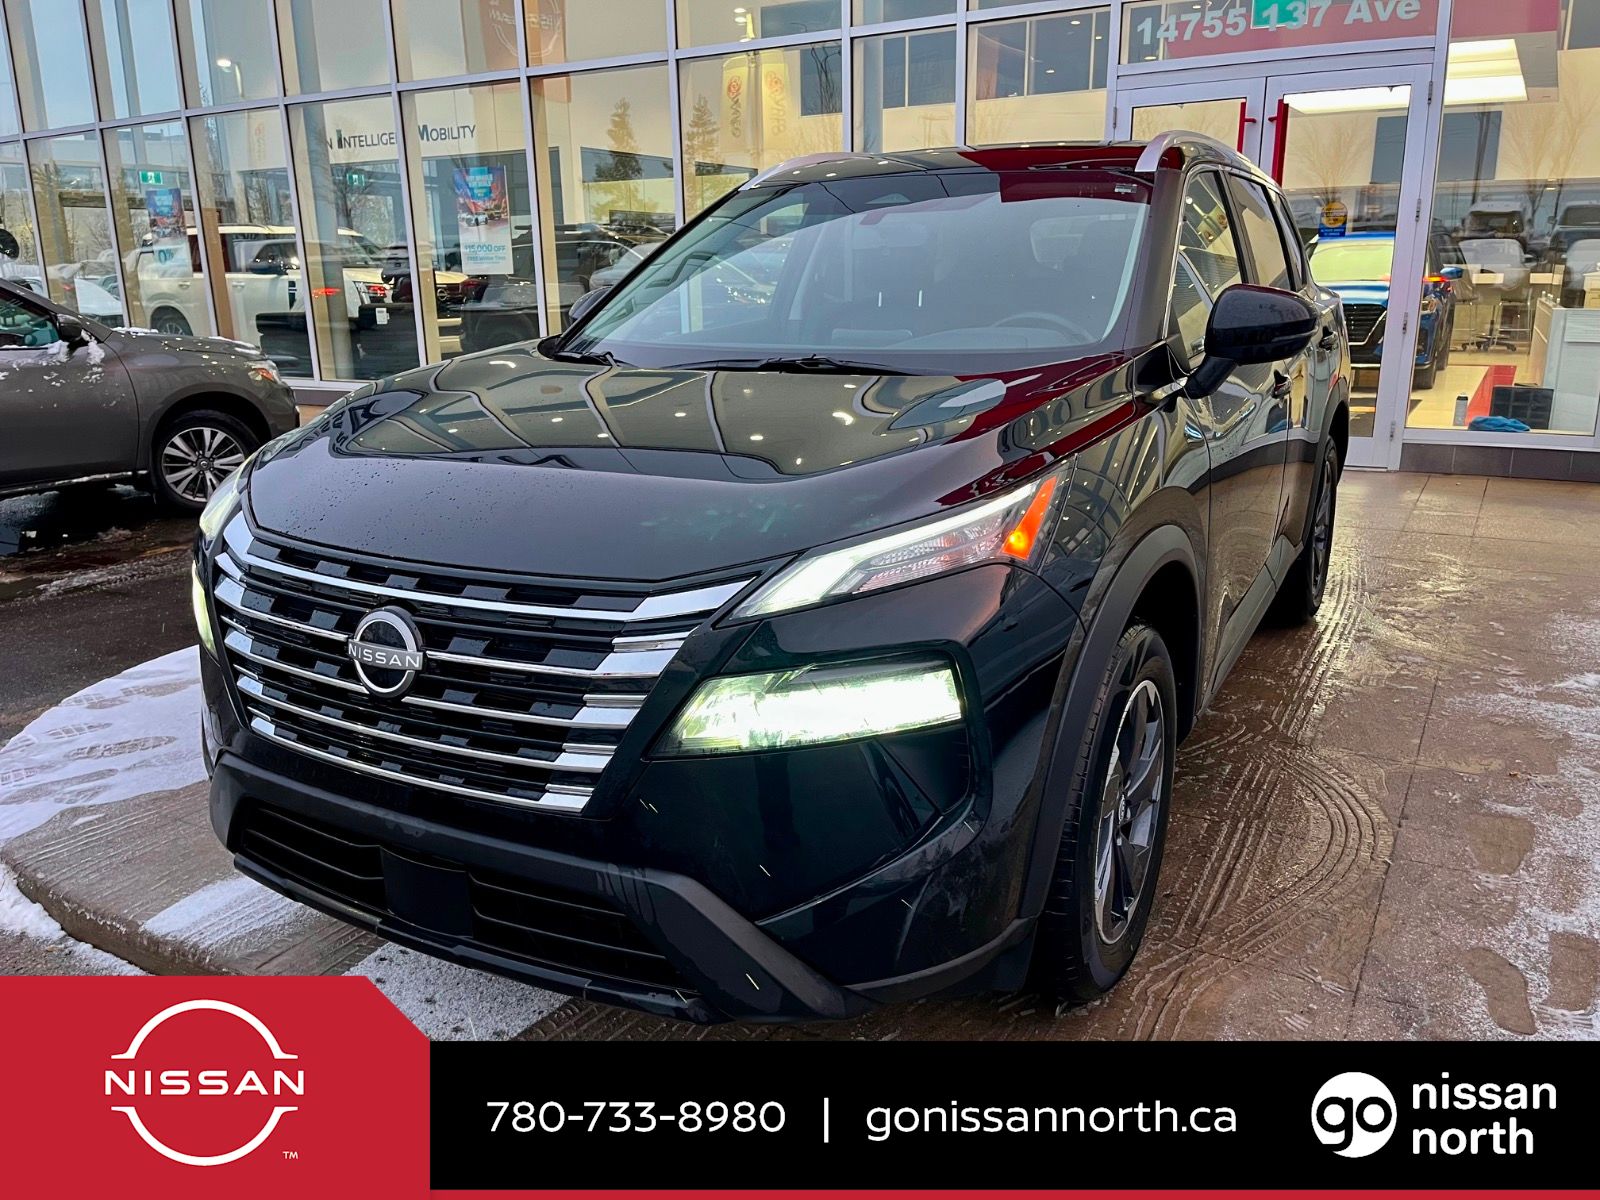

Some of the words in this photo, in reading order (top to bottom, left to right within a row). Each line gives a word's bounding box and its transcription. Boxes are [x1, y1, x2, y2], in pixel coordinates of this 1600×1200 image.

[1137, 7, 1247, 45] 14755
[1262, 0, 1330, 32] 137
[1344, 0, 1421, 25] Ave
[336, 129, 398, 150] INTELLIGE
[418, 124, 476, 142] MOBILITY
[348, 643, 420, 668] NISSAN
